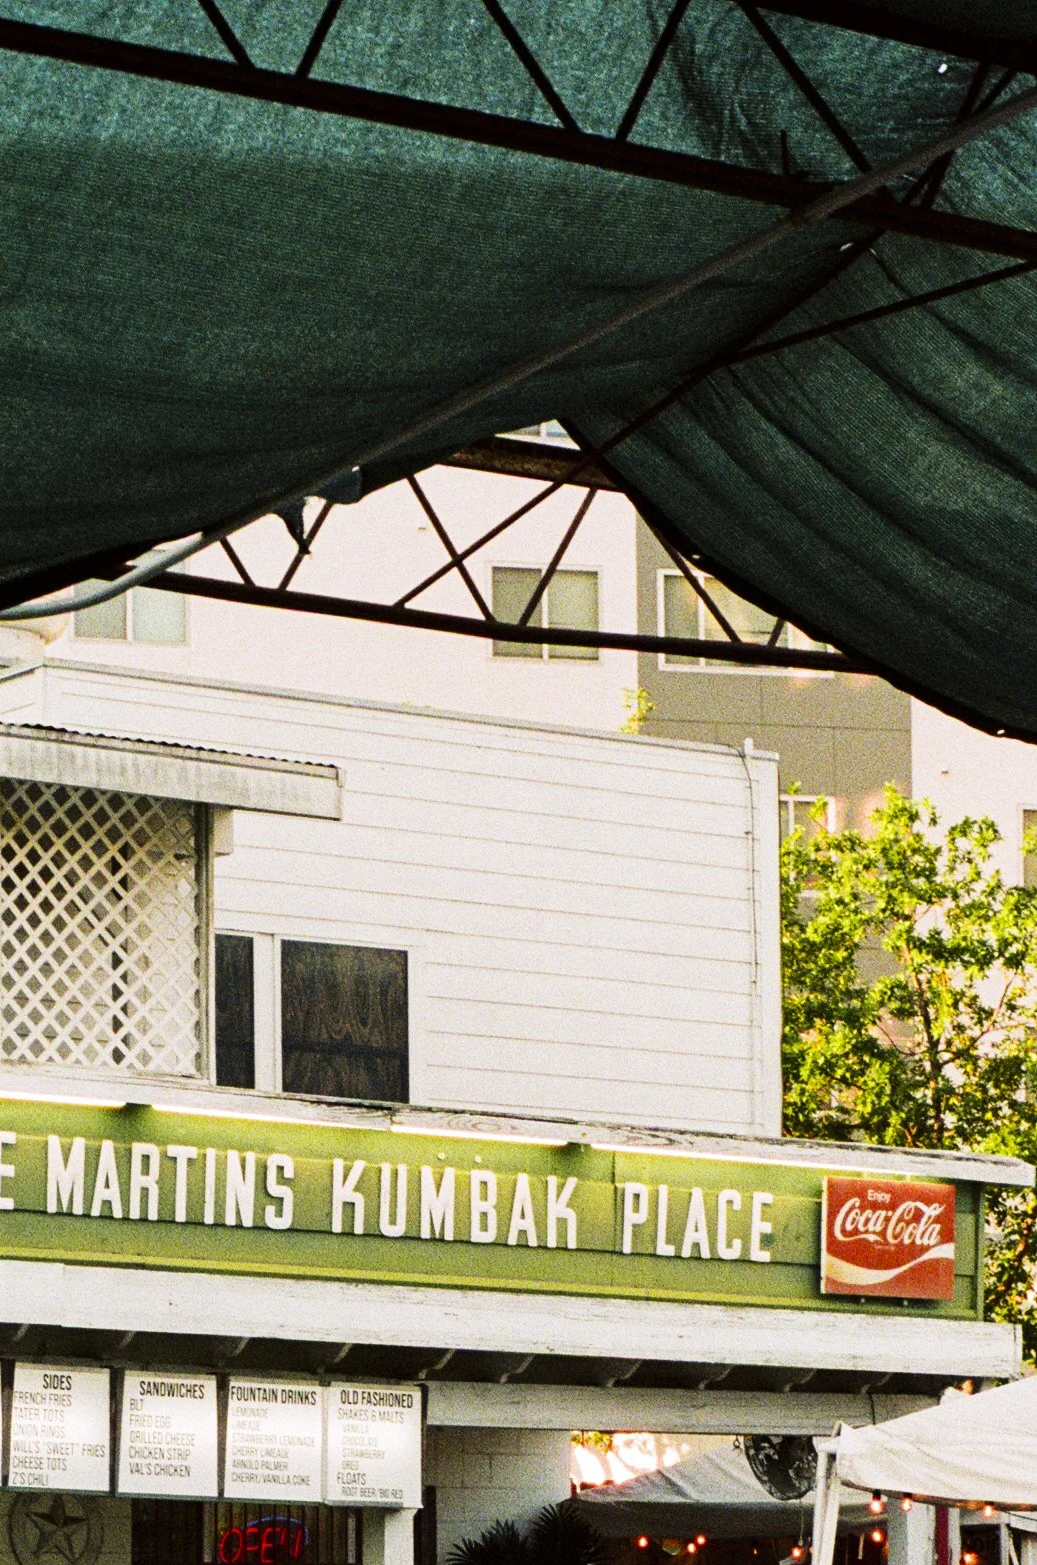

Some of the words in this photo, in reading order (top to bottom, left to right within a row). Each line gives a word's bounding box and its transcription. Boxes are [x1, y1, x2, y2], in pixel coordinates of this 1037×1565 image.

[46, 1134, 294, 1230] MARTINS
[332, 1158, 578, 1249] KUMBAK
[622, 1182, 774, 1263] PLACE
[867, 1189, 891, 1204] Enjoy
[834, 1197, 946, 1246] Coca-Cola
[42, 1373, 72, 1391] SIDES
[139, 1380, 205, 1400] SANDWICHES
[230, 1386, 279, 1404] FOUNTAIN
[280, 1389, 317, 1406] DRINKS
[13, 1391, 47, 1405] FRENCH
[49, 1393, 72, 1407] FRIES
[129, 1398, 144, 1412] BLT
[339, 1389, 359, 1406] OLD
[361, 1391, 414, 1409] FASHIONED
[13, 1407, 40, 1421] TATER
[43, 1408, 65, 1422] TOTS
[232, 1407, 269, 1419] LEMONADE
[337, 1407, 370, 1421] SHAKES
[378, 1410, 405, 1425] MALTS
[129, 1414, 153, 1428] FRIED
[155, 1416, 171, 1429] EGG
[13, 1423, 38, 1437] ONION
[41, 1425, 66, 1439] RINGS
[129, 1431, 163, 1445] GRILLED
[165, 1432, 196, 1447] CHEESE
[82, 1443, 106, 1457] FRIES
[128, 1446, 165, 1461] CHICKEN
[167, 1448, 192, 1462] STRIP
[232, 1446, 258, 1457] CHERRY
[342, 1448, 386, 1460] STRAWBERRY
[12, 1456, 44, 1470] CHEESE
[47, 1457, 67, 1471] TOTS
[153, 1463, 191, 1478] CHICKEN
[232, 1459, 260, 1471] ARNOLD
[261, 1460, 289, 1472] PALMER
[27, 1473, 50, 1486] CHILI
[293, 1474, 312, 1487] COKE
[337, 1472, 367, 1486] FLOATS
[342, 1486, 359, 1498] ROOT
[219, 1526, 303, 1565] OPEN
